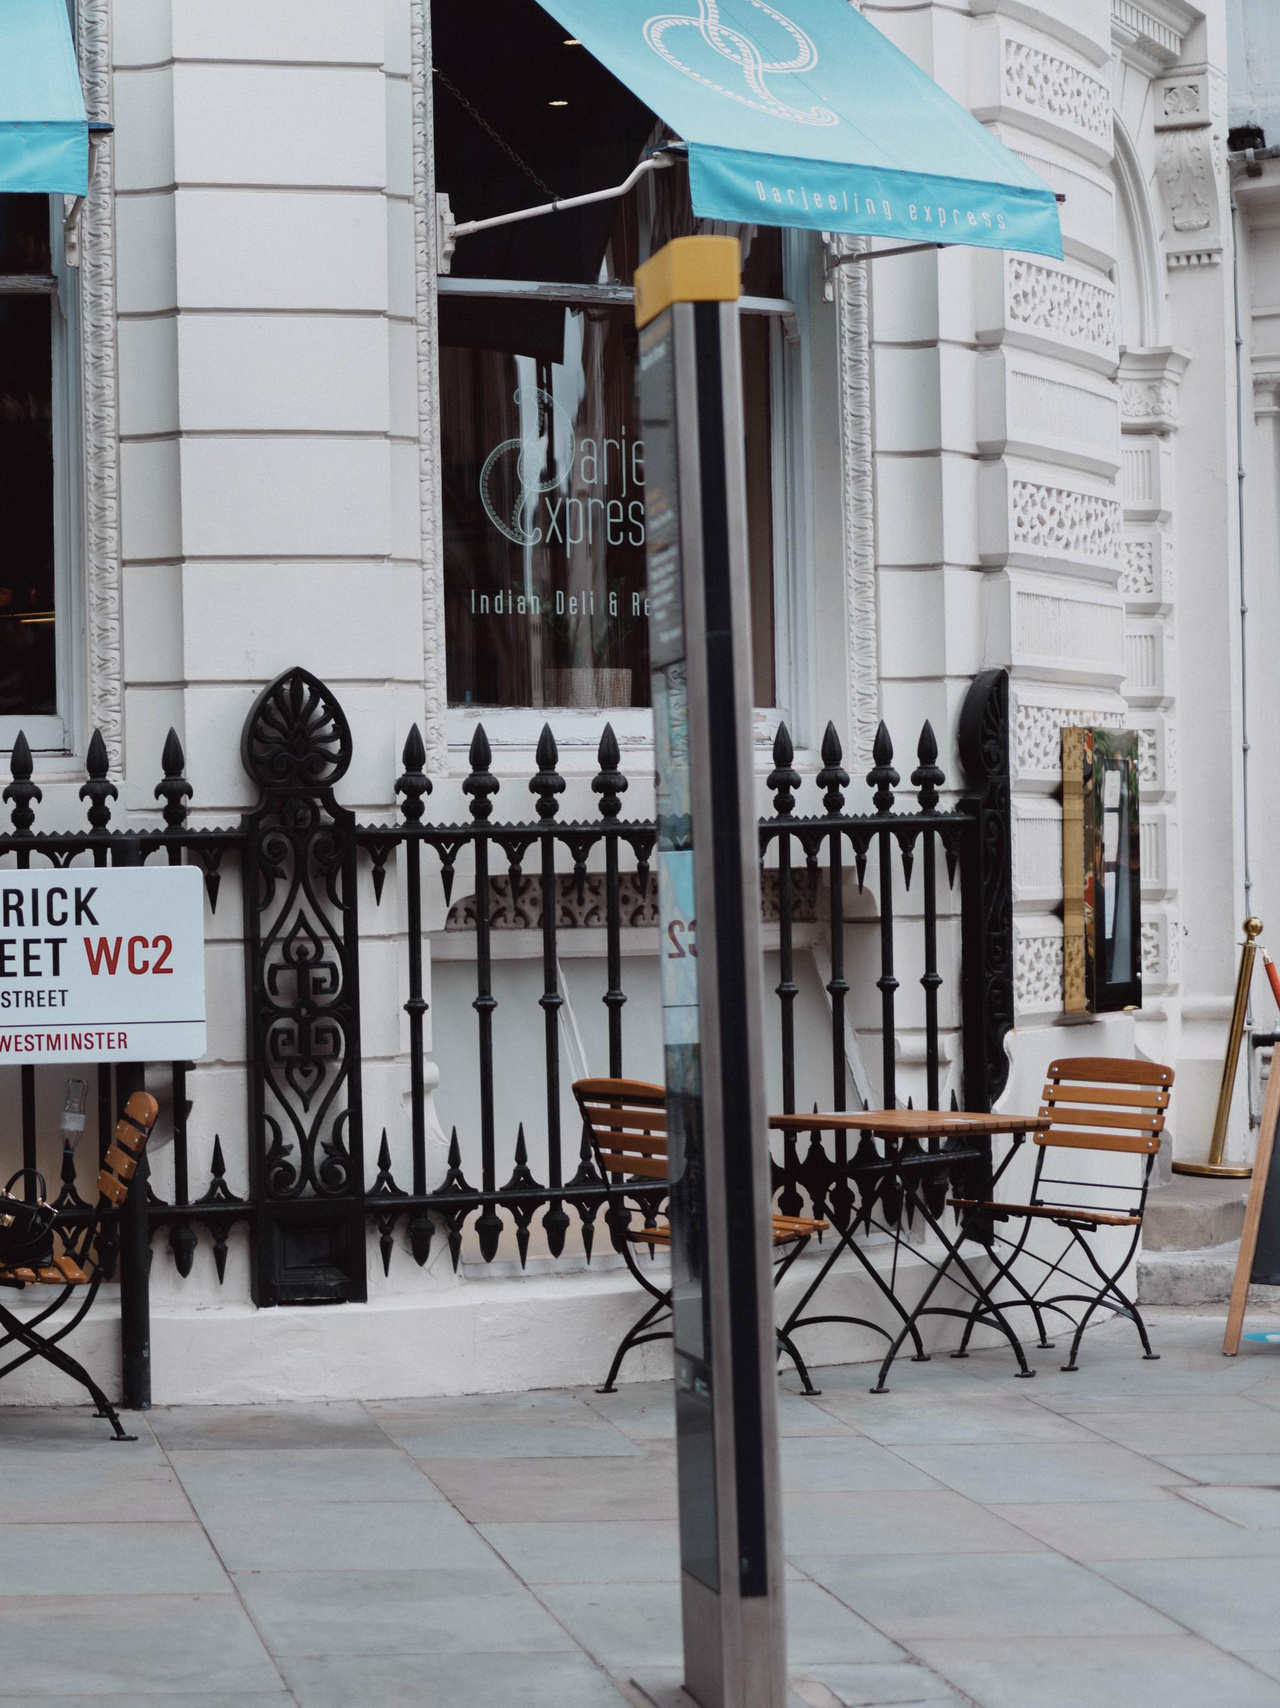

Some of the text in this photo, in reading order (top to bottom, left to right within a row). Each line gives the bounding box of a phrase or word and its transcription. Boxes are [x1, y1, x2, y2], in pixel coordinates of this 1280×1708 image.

[755, 180, 1006, 230] Darjeeling express
[470, 589, 540, 615] Indian
[556, 591, 594, 616] Deli
[609, 592, 618, 617] &
[83, 934, 174, 976] WC2
[0, 989, 69, 1009] STREET
